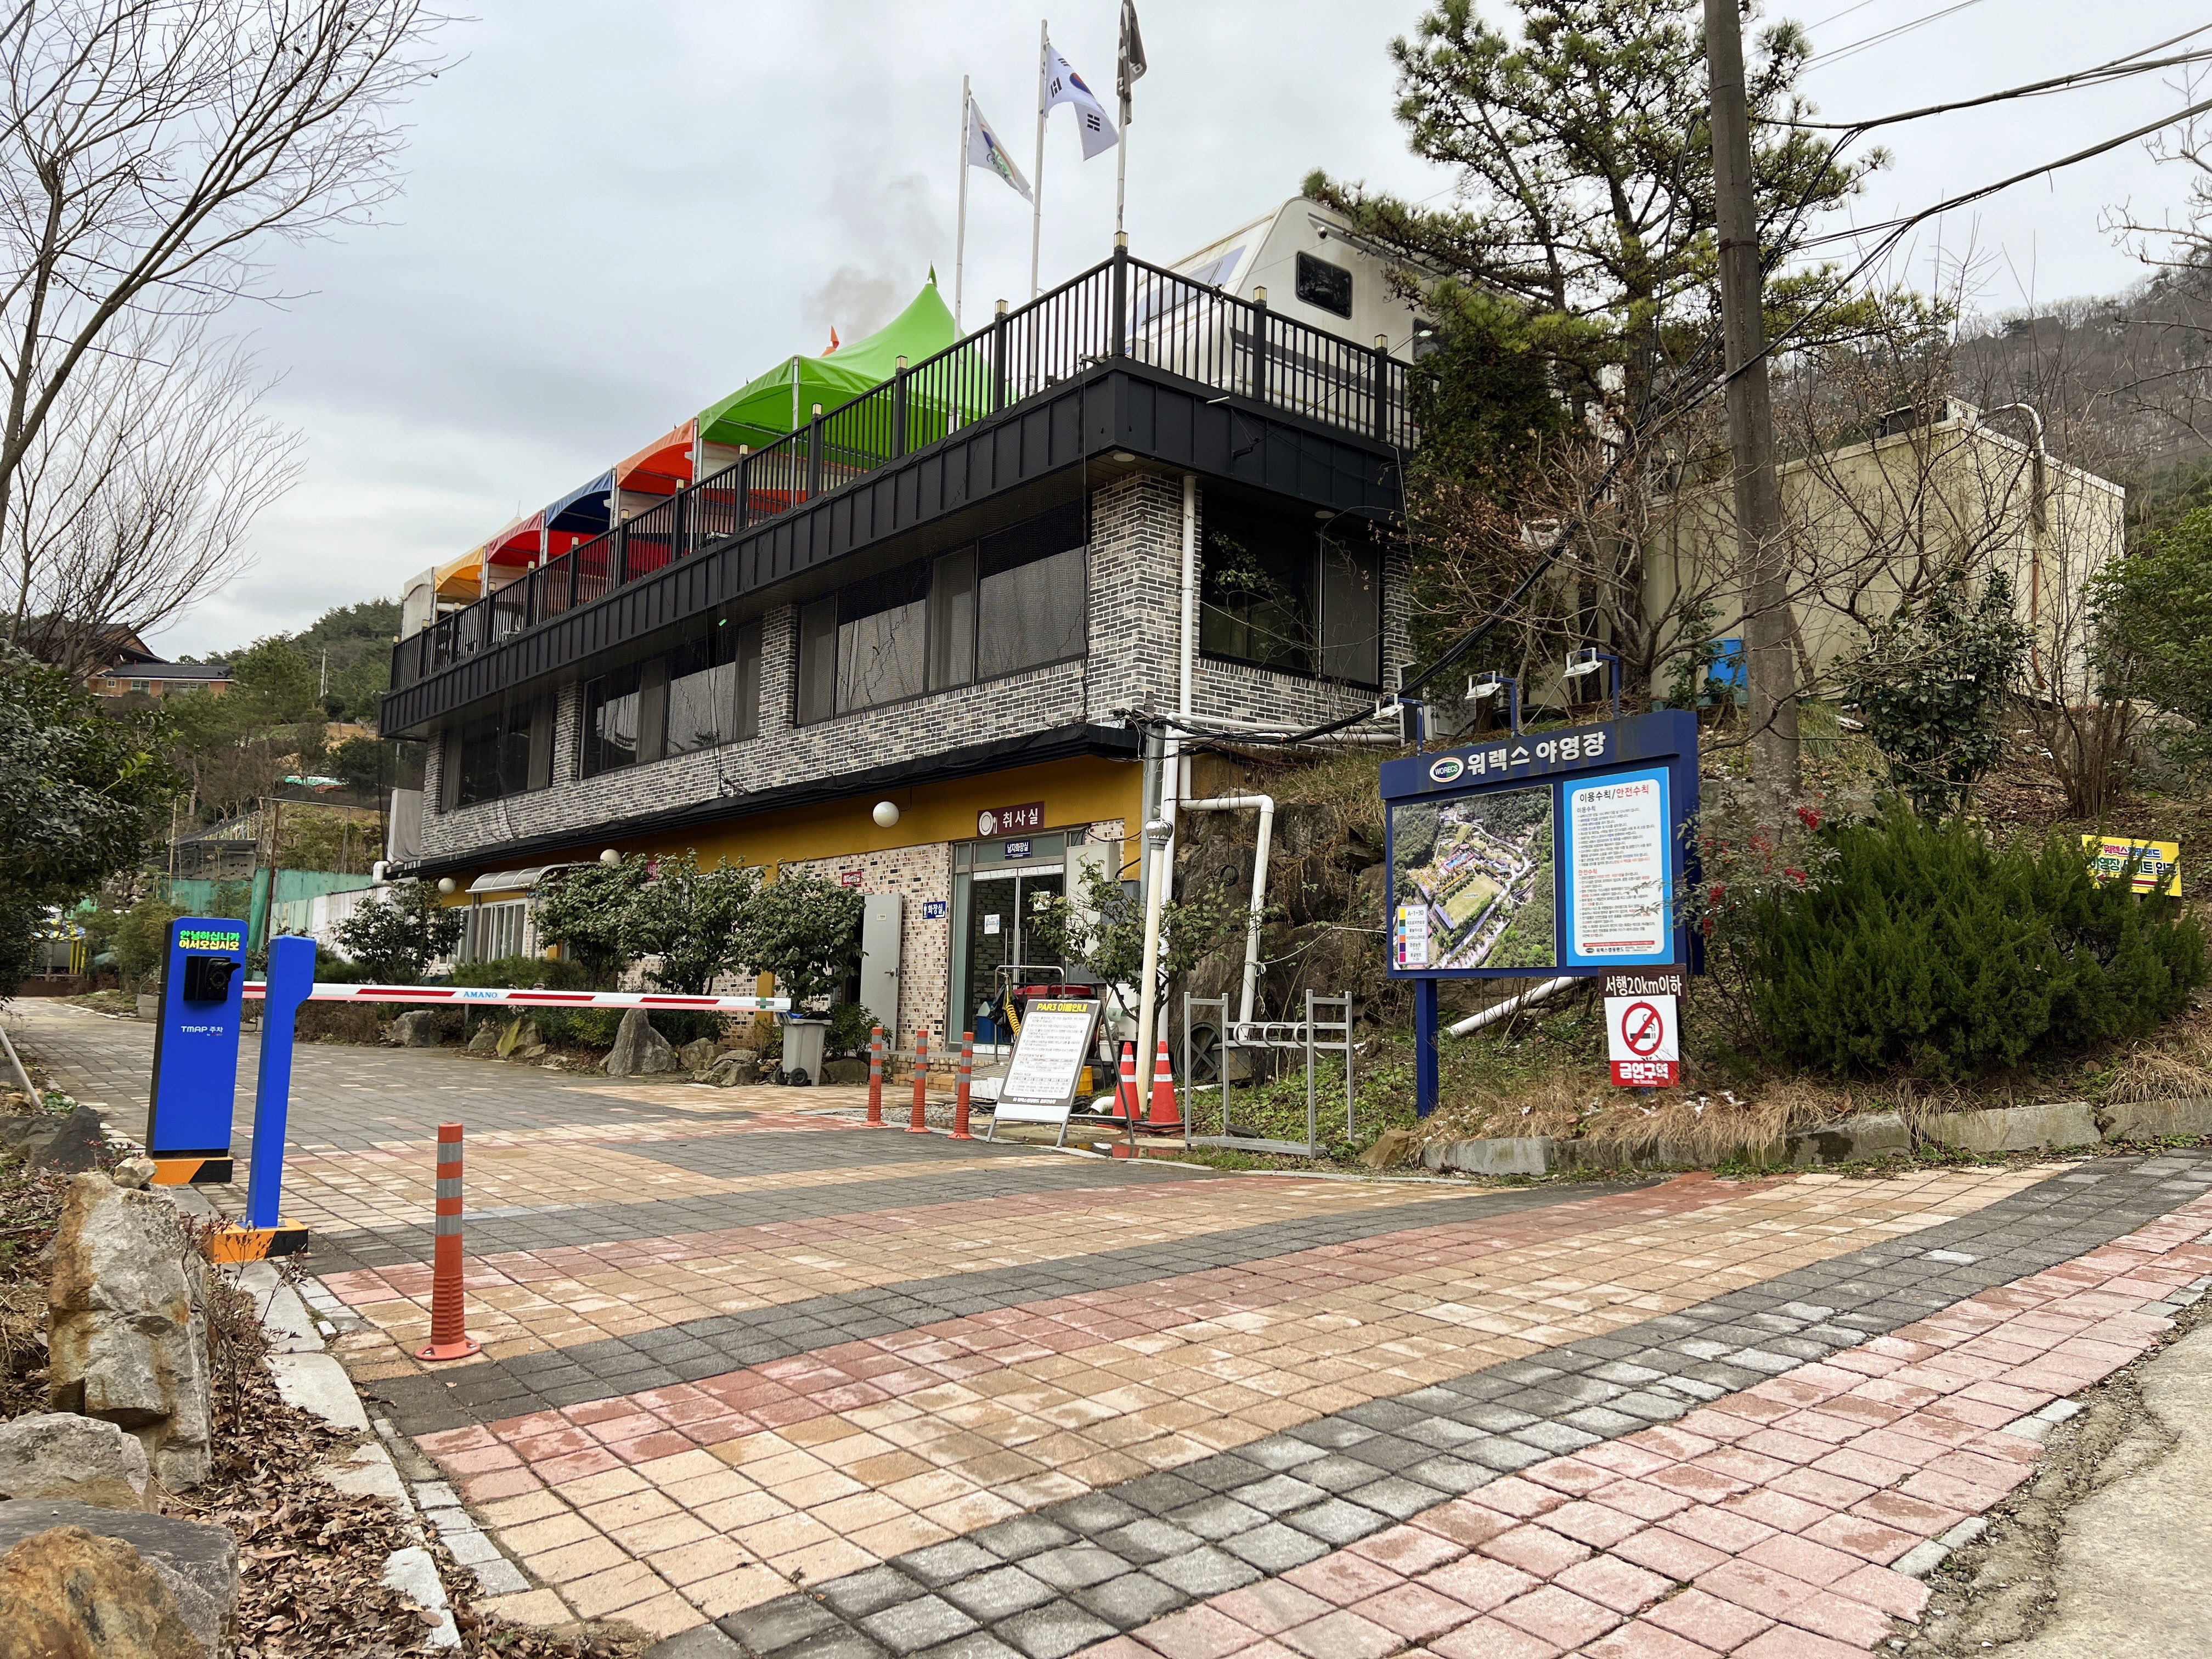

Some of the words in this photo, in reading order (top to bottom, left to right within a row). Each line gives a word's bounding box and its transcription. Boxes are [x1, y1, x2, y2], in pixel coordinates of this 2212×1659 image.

[1468, 747, 1531, 776] 워렉스
[1536, 731, 1606, 764] 야영장
[1435, 765, 1459, 775] WORECS
[1003, 808, 1038, 828] 취사실
[1007, 842, 1029, 853] 남자화장실
[2103, 845, 2160, 858] 워렉스핑랜드
[928, 904, 943, 915] 화장실
[180, 930, 240, 941] 안녕하십니까
[179, 940, 239, 950] 어서오십시오
[1606, 975, 1683, 996] 서행20km이하
[1036, 1003, 1057, 1011] PAR3
[1058, 1003, 1088, 1012] 이용안내
[1619, 1062, 1669, 1079] 금연구역
